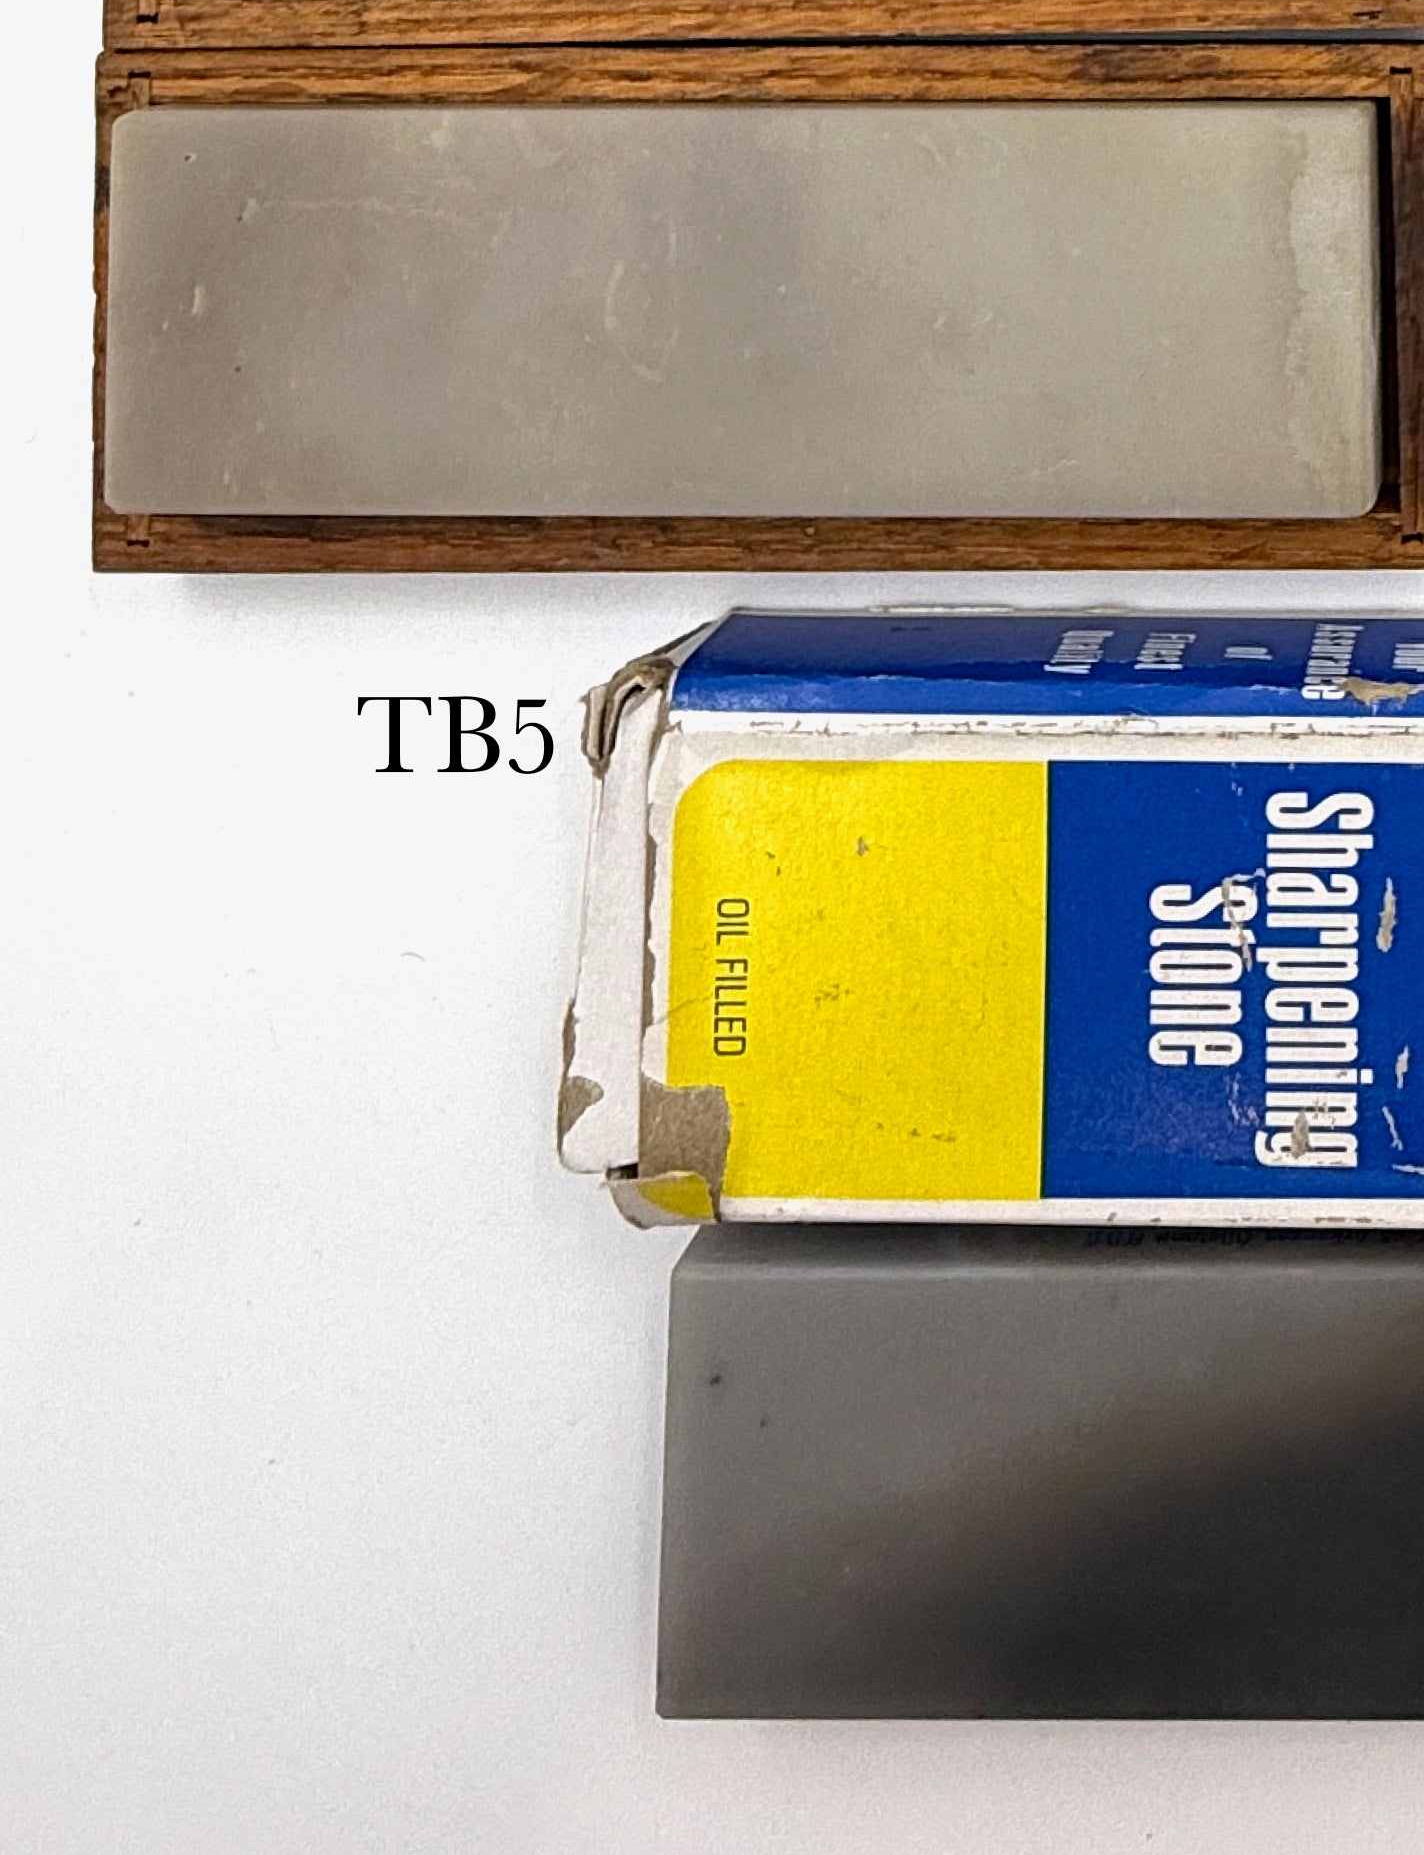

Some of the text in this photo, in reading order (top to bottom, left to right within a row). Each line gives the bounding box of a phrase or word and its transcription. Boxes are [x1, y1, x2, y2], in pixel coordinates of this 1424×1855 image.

[713, 898, 750, 1057] OIL FILLED
[1149, 884, 1260, 1068] Stone
[1255, 791, 1376, 1168] Sharpening
